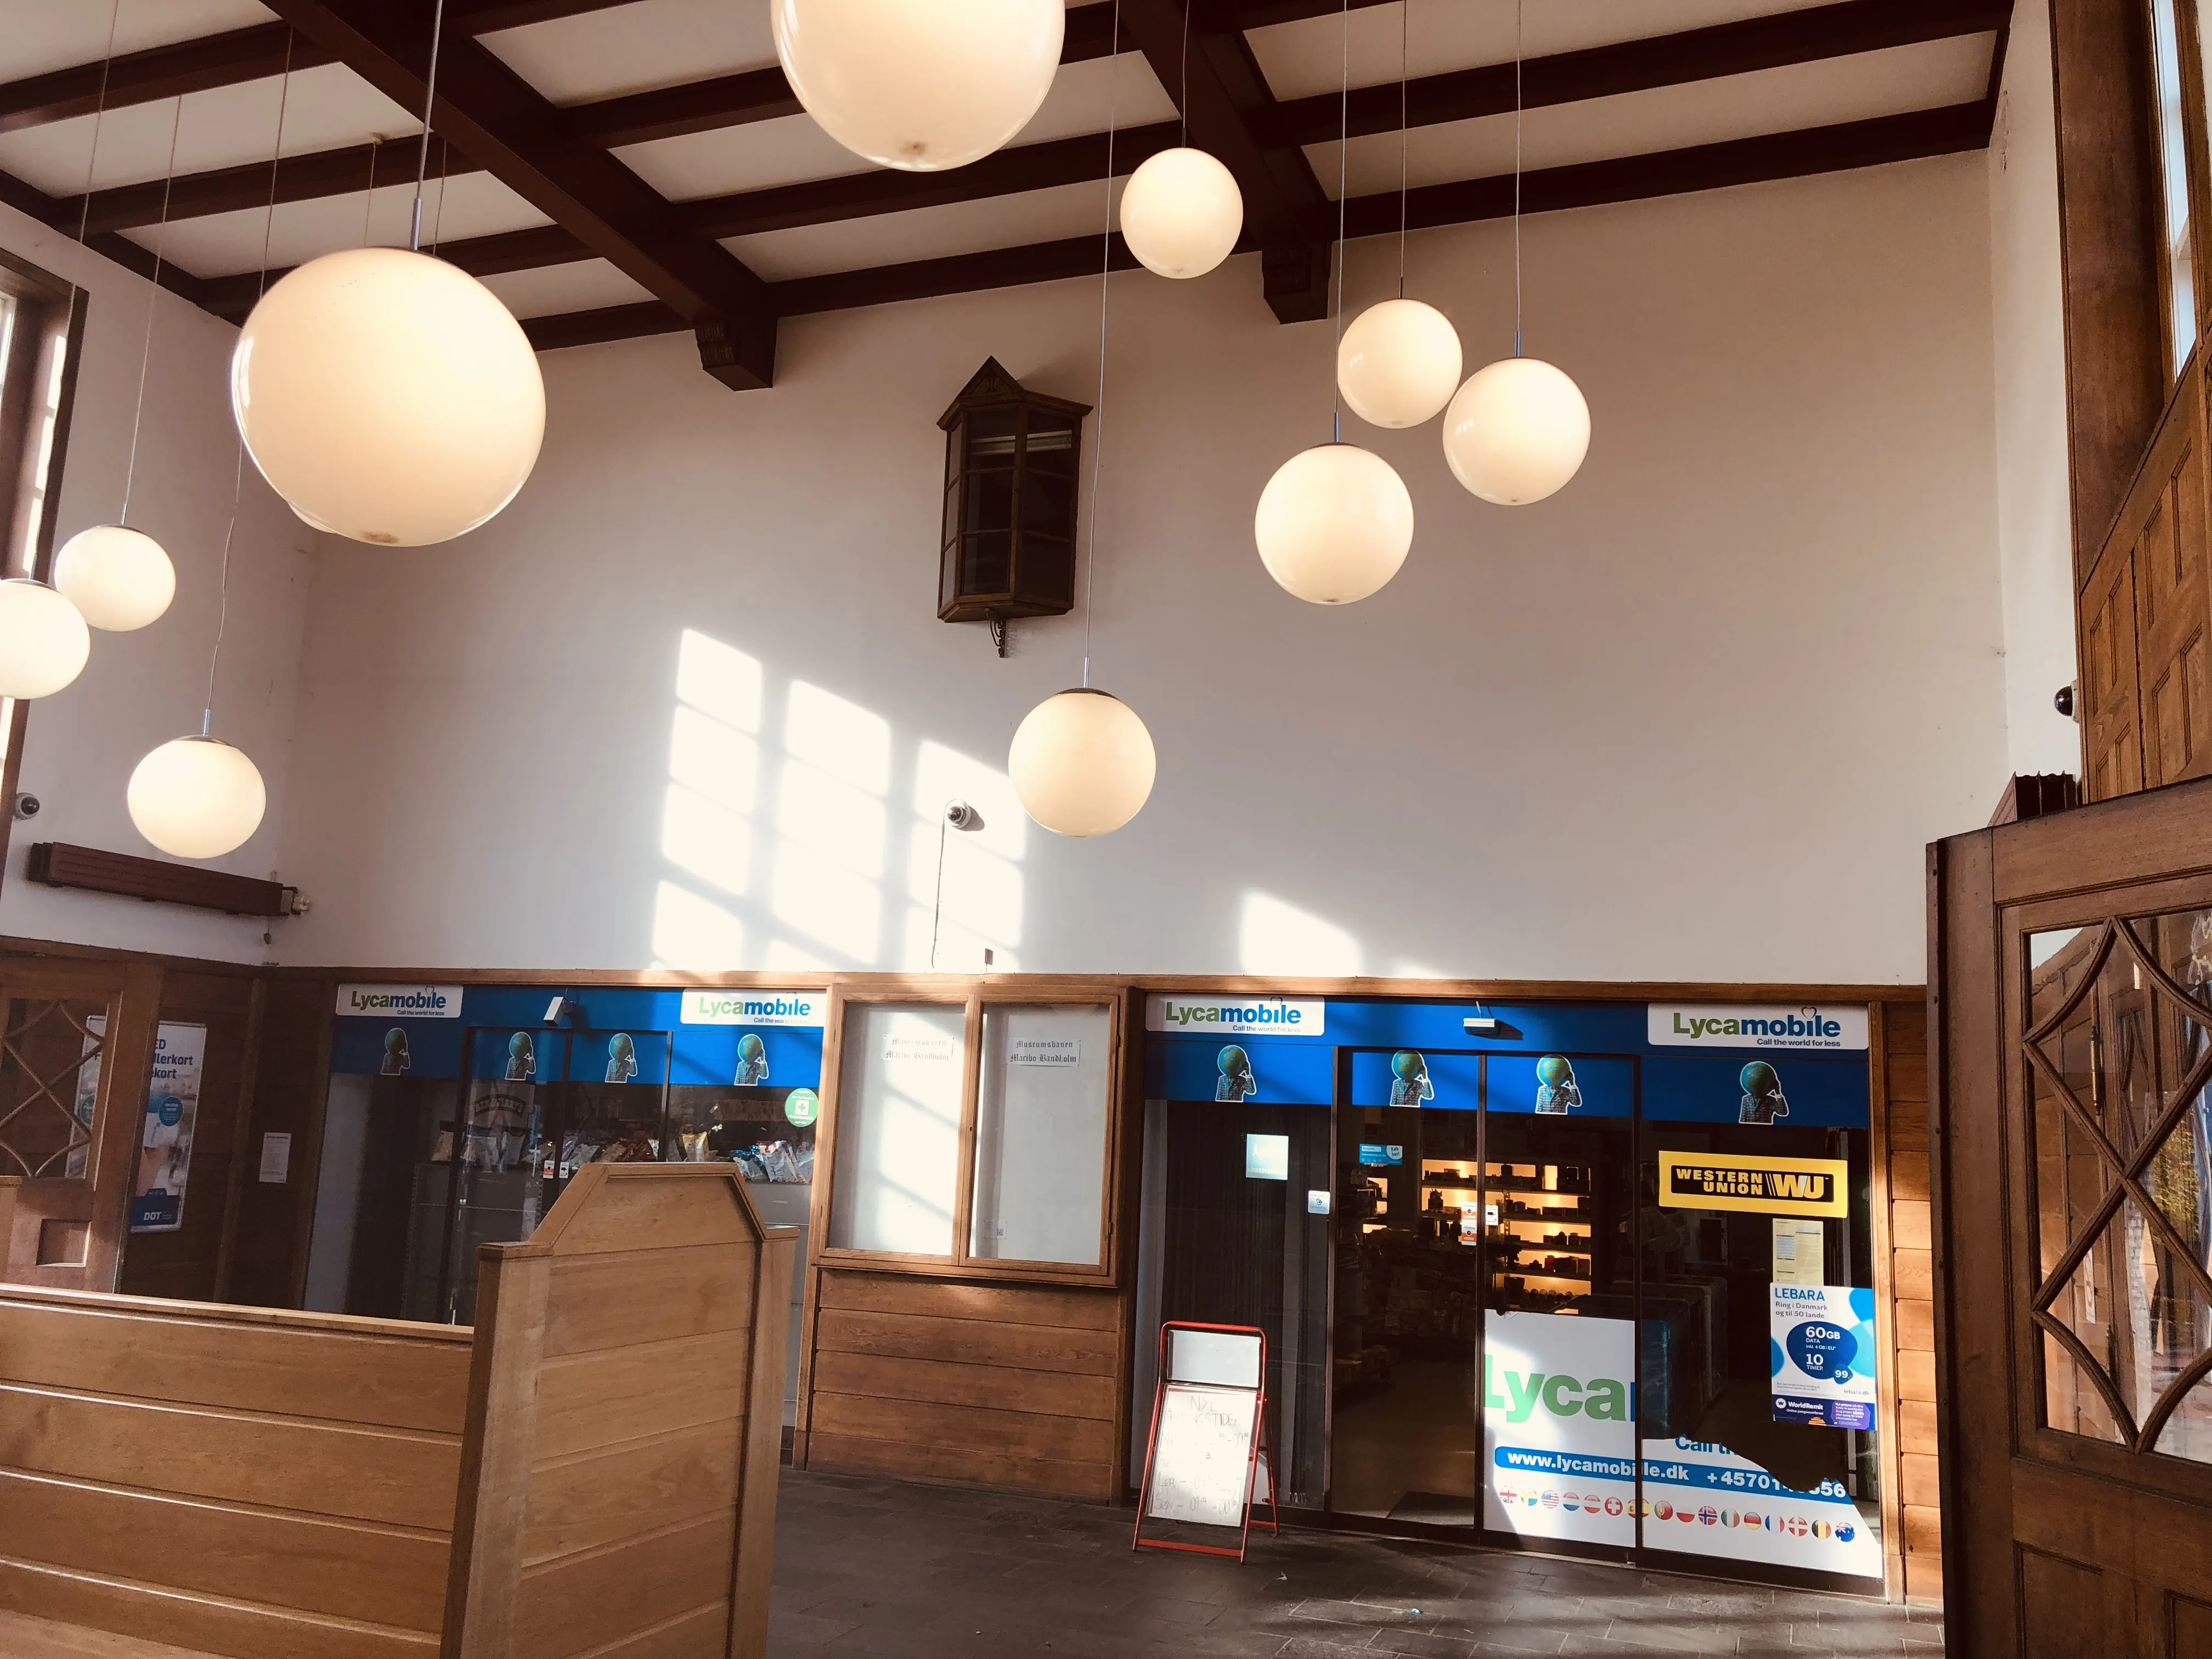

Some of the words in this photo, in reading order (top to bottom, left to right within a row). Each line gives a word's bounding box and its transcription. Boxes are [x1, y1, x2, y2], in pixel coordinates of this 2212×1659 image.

[351, 990, 446, 1010] Lycamobile
[699, 997, 811, 1017] Lycamobile
[1166, 1002, 1301, 1025] Lycamobile
[1673, 1012, 1841, 1039] Lycamobile
[1015, 1040, 1073, 1048] Museumsbanen
[1676, 1168, 1762, 1184] WESTERN
[1772, 1173, 1824, 1199] WU
[1703, 1181, 1762, 1195] UNION
[144, 1212, 162, 1221] DOT
[1775, 1288, 1825, 1301] LEBARA
[1775, 1301, 1791, 1310] Ring
[1805, 1326, 1841, 1340] 60GB
[1806, 1353, 1824, 1365] 10
[1484, 1353, 1635, 1423] Lyca
[1190, 1396, 1218, 1412] NYE
[1788, 1401, 1824, 1410] WorldRemit
[1507, 1452, 1690, 1481] www.lycamobile.dk
[1707, 1470, 1847, 1498] +4570156
